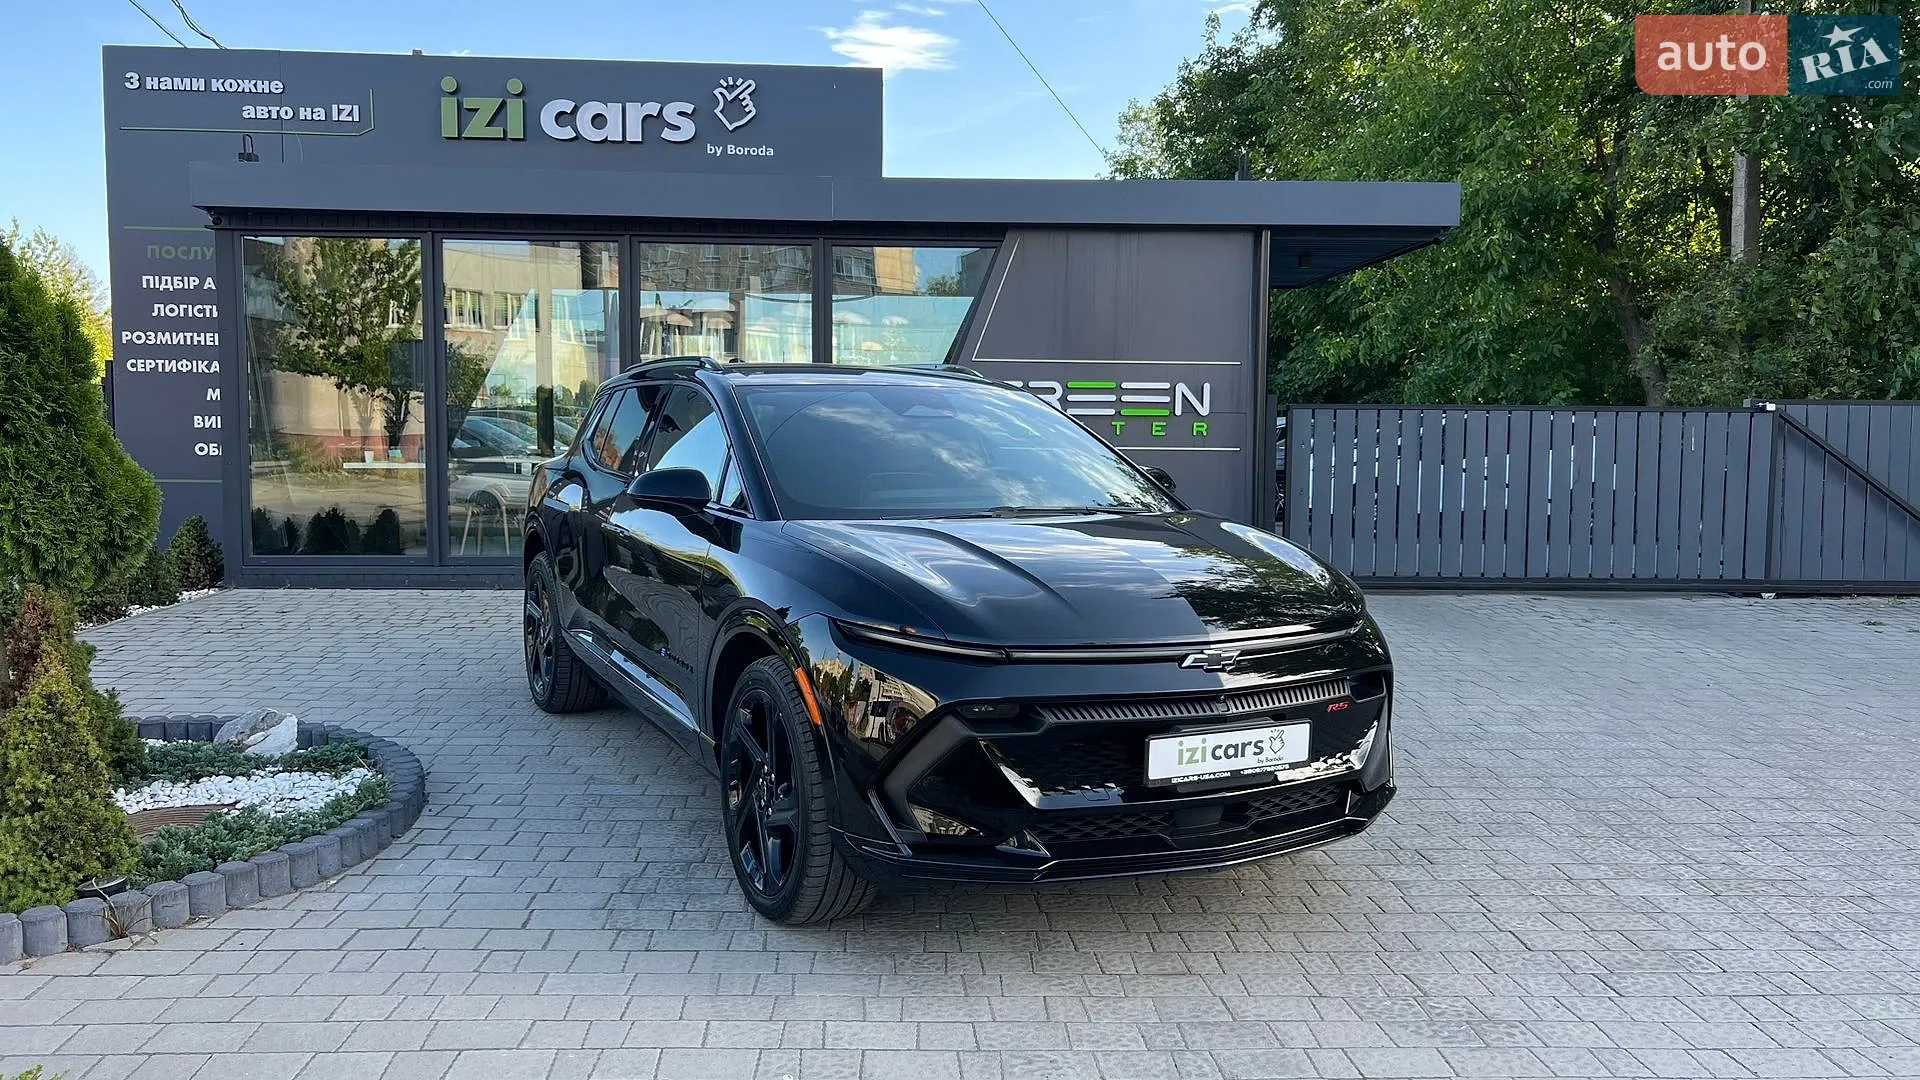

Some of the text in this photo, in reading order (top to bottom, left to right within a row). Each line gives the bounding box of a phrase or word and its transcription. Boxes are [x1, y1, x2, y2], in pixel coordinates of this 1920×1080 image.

[124, 72, 284, 94] З нами кожне
[242, 103, 361, 122] авто на IZI
[441, 76, 697, 142] izi cars
[706, 143, 775, 157] by Boroda
[146, 244, 214, 260] ПОСЛУ
[142, 275, 200, 291] ПІДБІР
[1003, 380, 1211, 416] REEN
[1080, 421, 1208, 436] TER
[194, 442, 223, 456] ОБ
[1327, 701, 1350, 713] RS
[1177, 737, 1265, 766] izi cars
